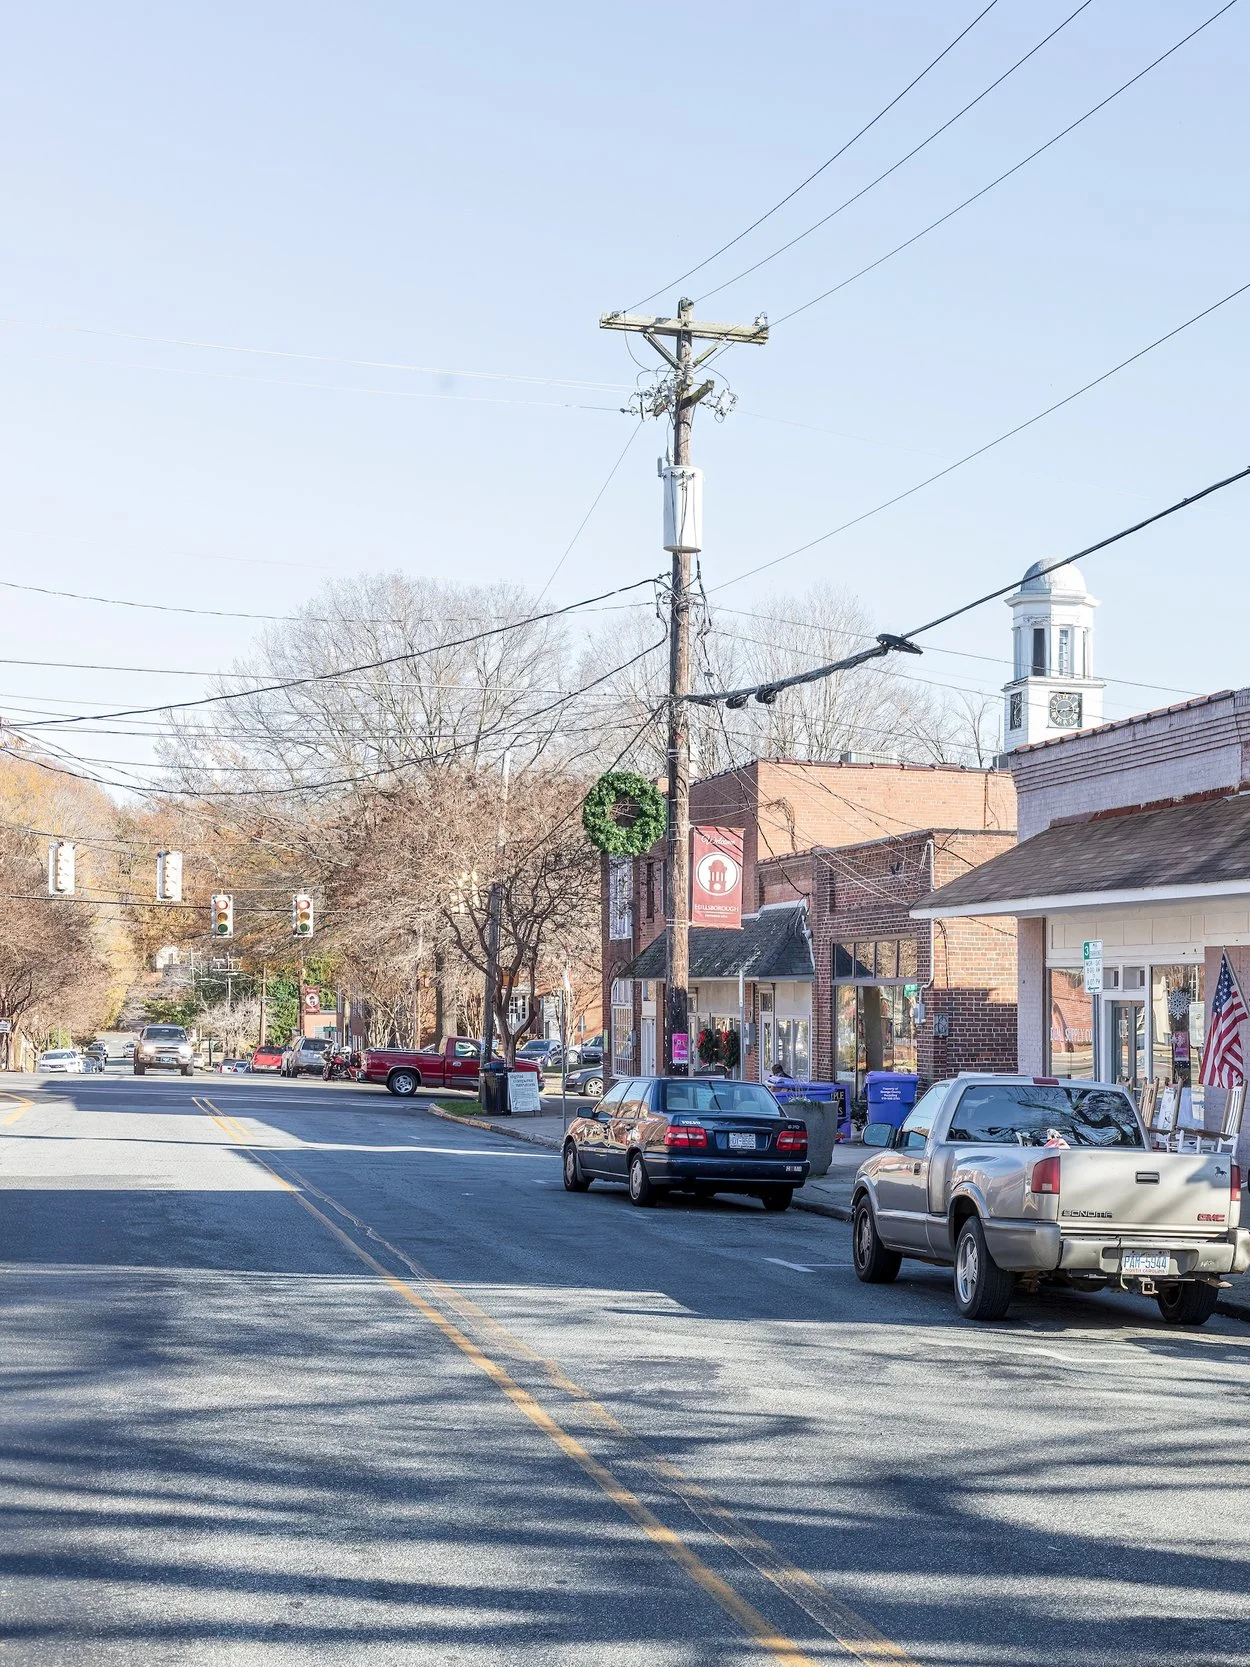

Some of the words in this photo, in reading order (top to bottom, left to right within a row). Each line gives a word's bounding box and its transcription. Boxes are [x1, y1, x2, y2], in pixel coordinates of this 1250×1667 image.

[694, 903, 739, 912] HILLSBOROUGH
[1084, 945, 1089, 956] 3
[1061, 1209, 1113, 1218] SONOMA
[1197, 1213, 1225, 1222] GMC
[1123, 1255, 1167, 1268] PAM-5944
